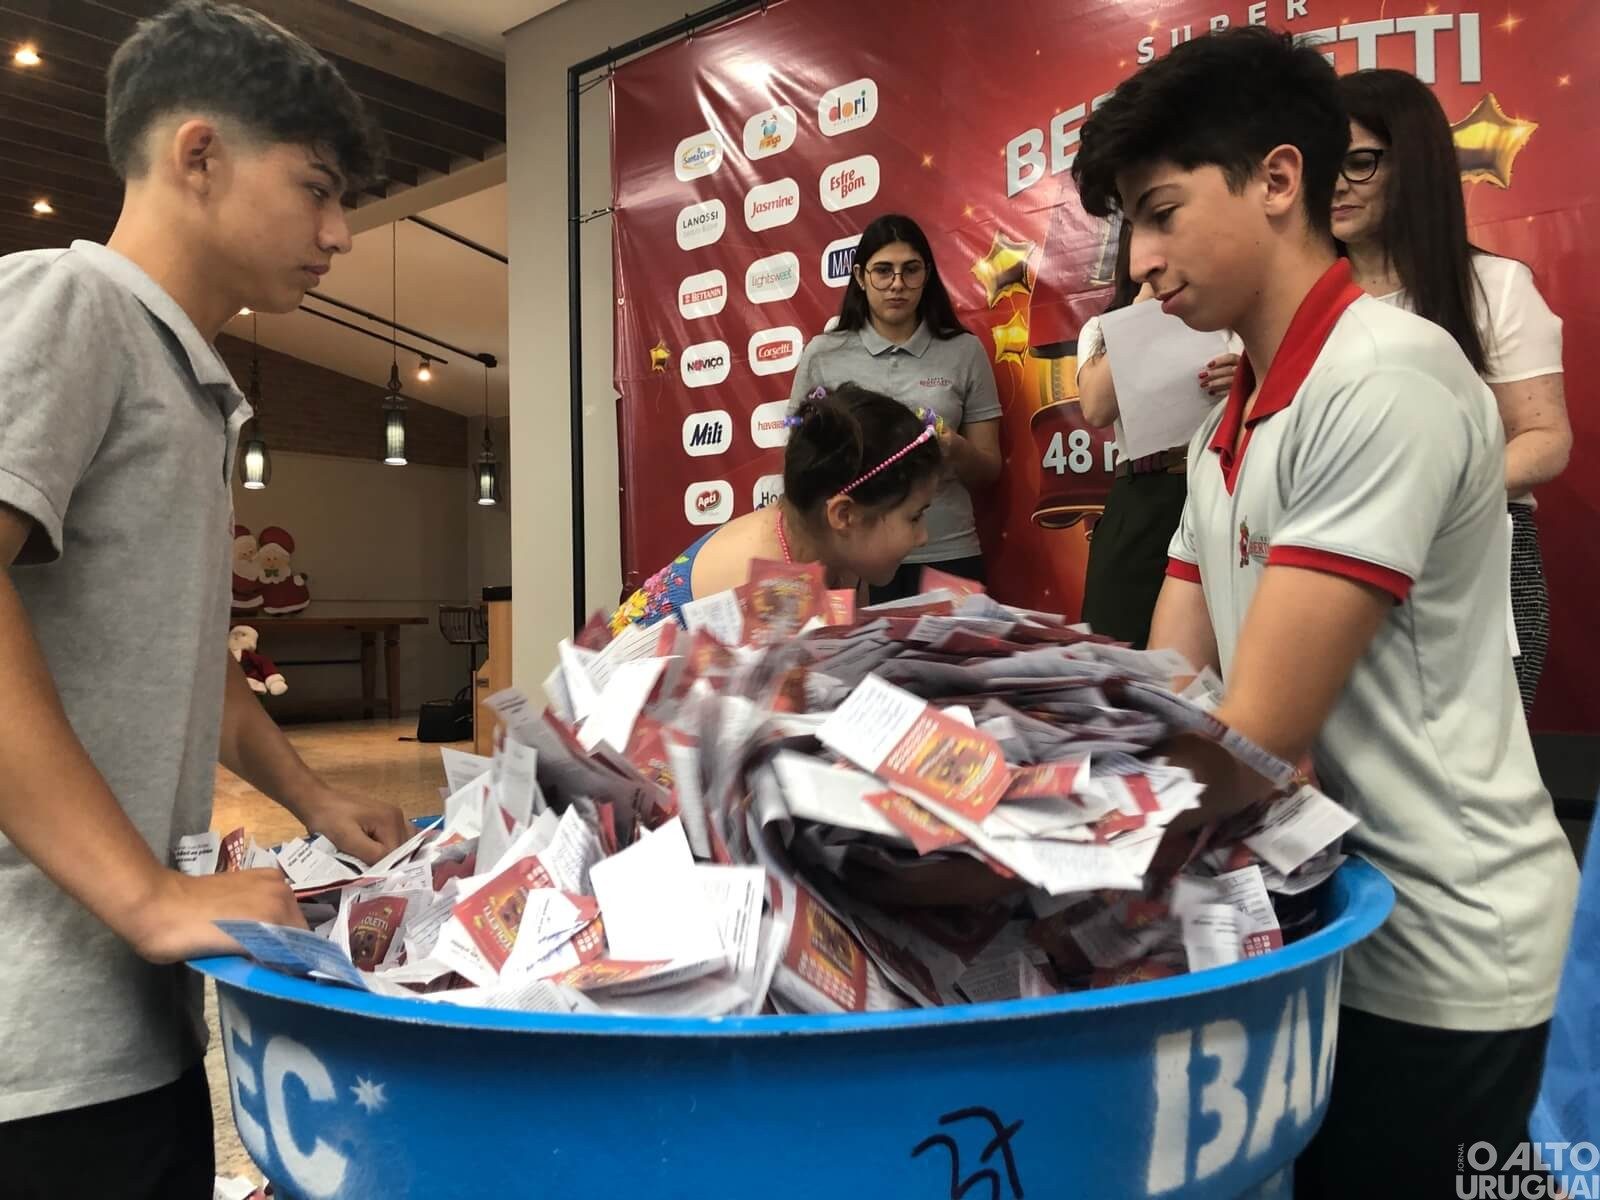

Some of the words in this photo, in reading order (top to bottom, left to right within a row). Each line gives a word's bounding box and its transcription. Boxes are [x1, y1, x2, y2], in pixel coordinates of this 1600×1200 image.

[828, 90, 866, 122] dori
[830, 169, 855, 191] Esfre
[751, 195, 794, 219] Jasmine
[682, 211, 719, 229] LANOSSI
[751, 265, 794, 289] lightsweet
[691, 285, 722, 301] BETTANIN
[689, 421, 723, 447] Mili
[1042, 429, 1093, 475] 48
